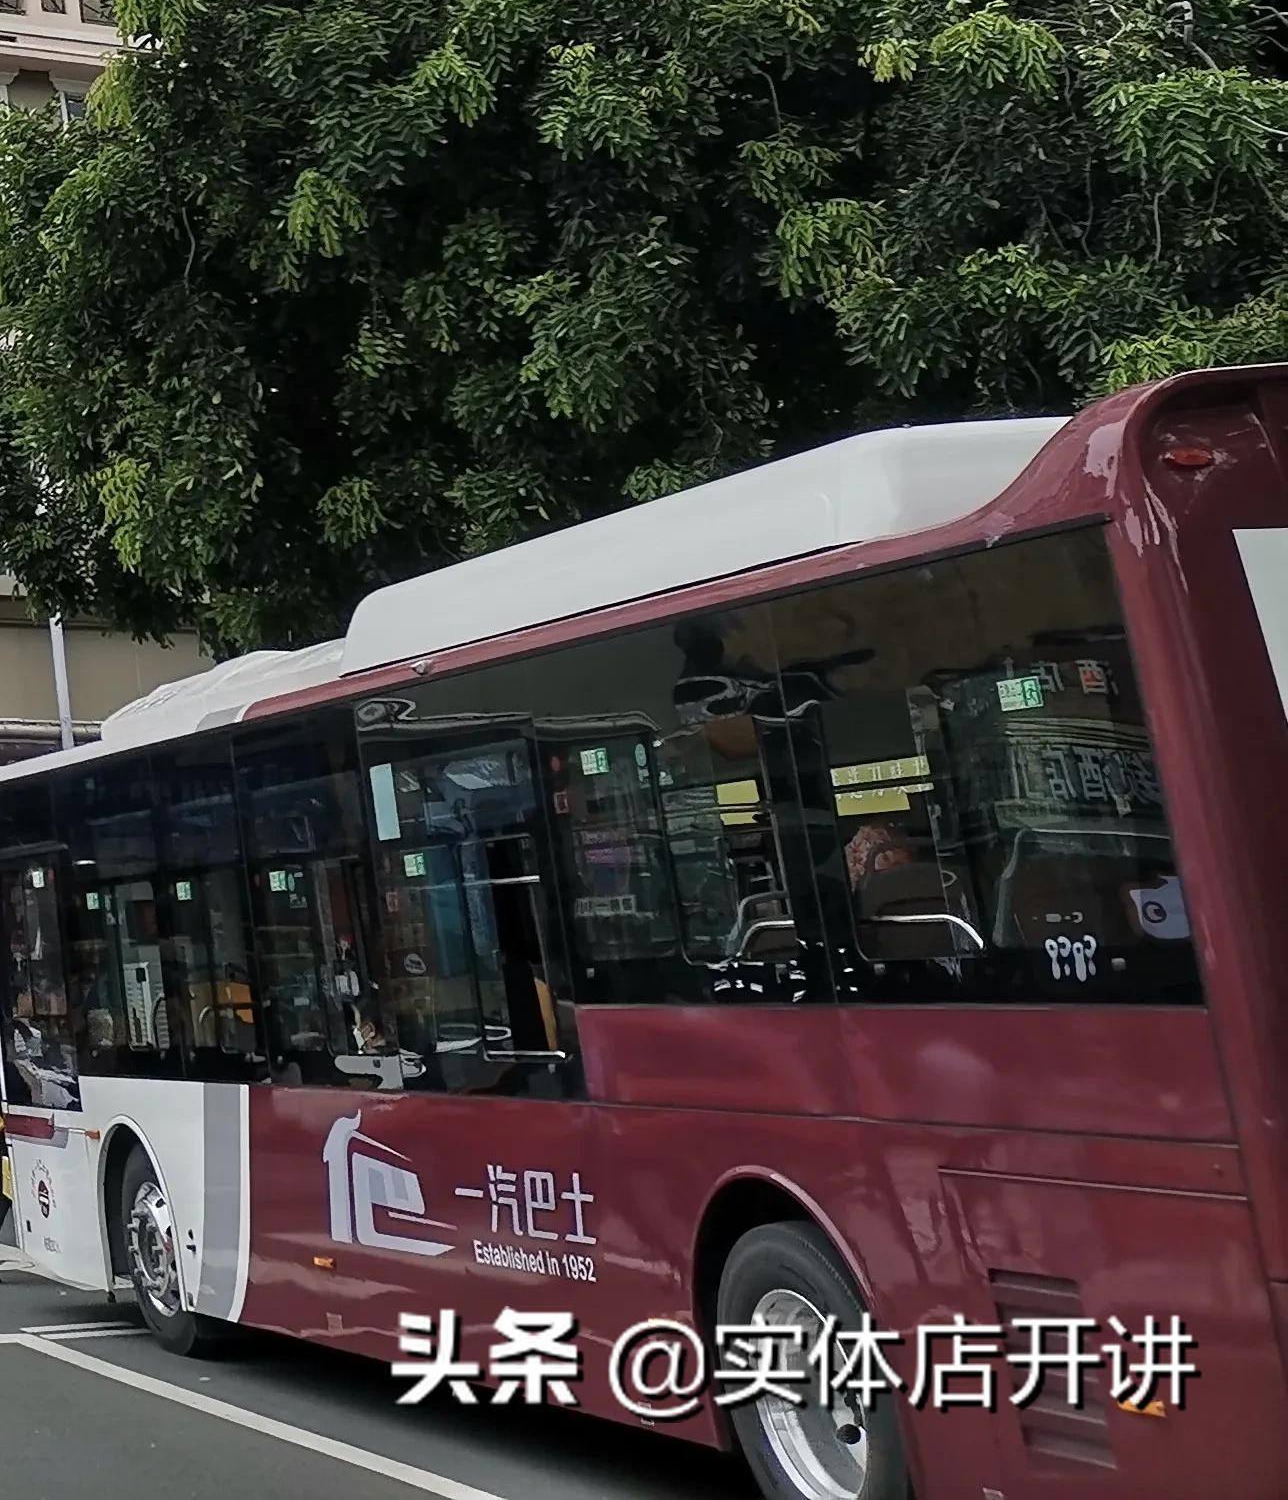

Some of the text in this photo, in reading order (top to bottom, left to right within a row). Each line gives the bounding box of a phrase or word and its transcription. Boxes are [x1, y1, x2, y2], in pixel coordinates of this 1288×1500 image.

[454, 1164, 597, 1245] 一汽巴士
[473, 1239, 545, 1275] Established
[562, 1253, 597, 1283] 1952
